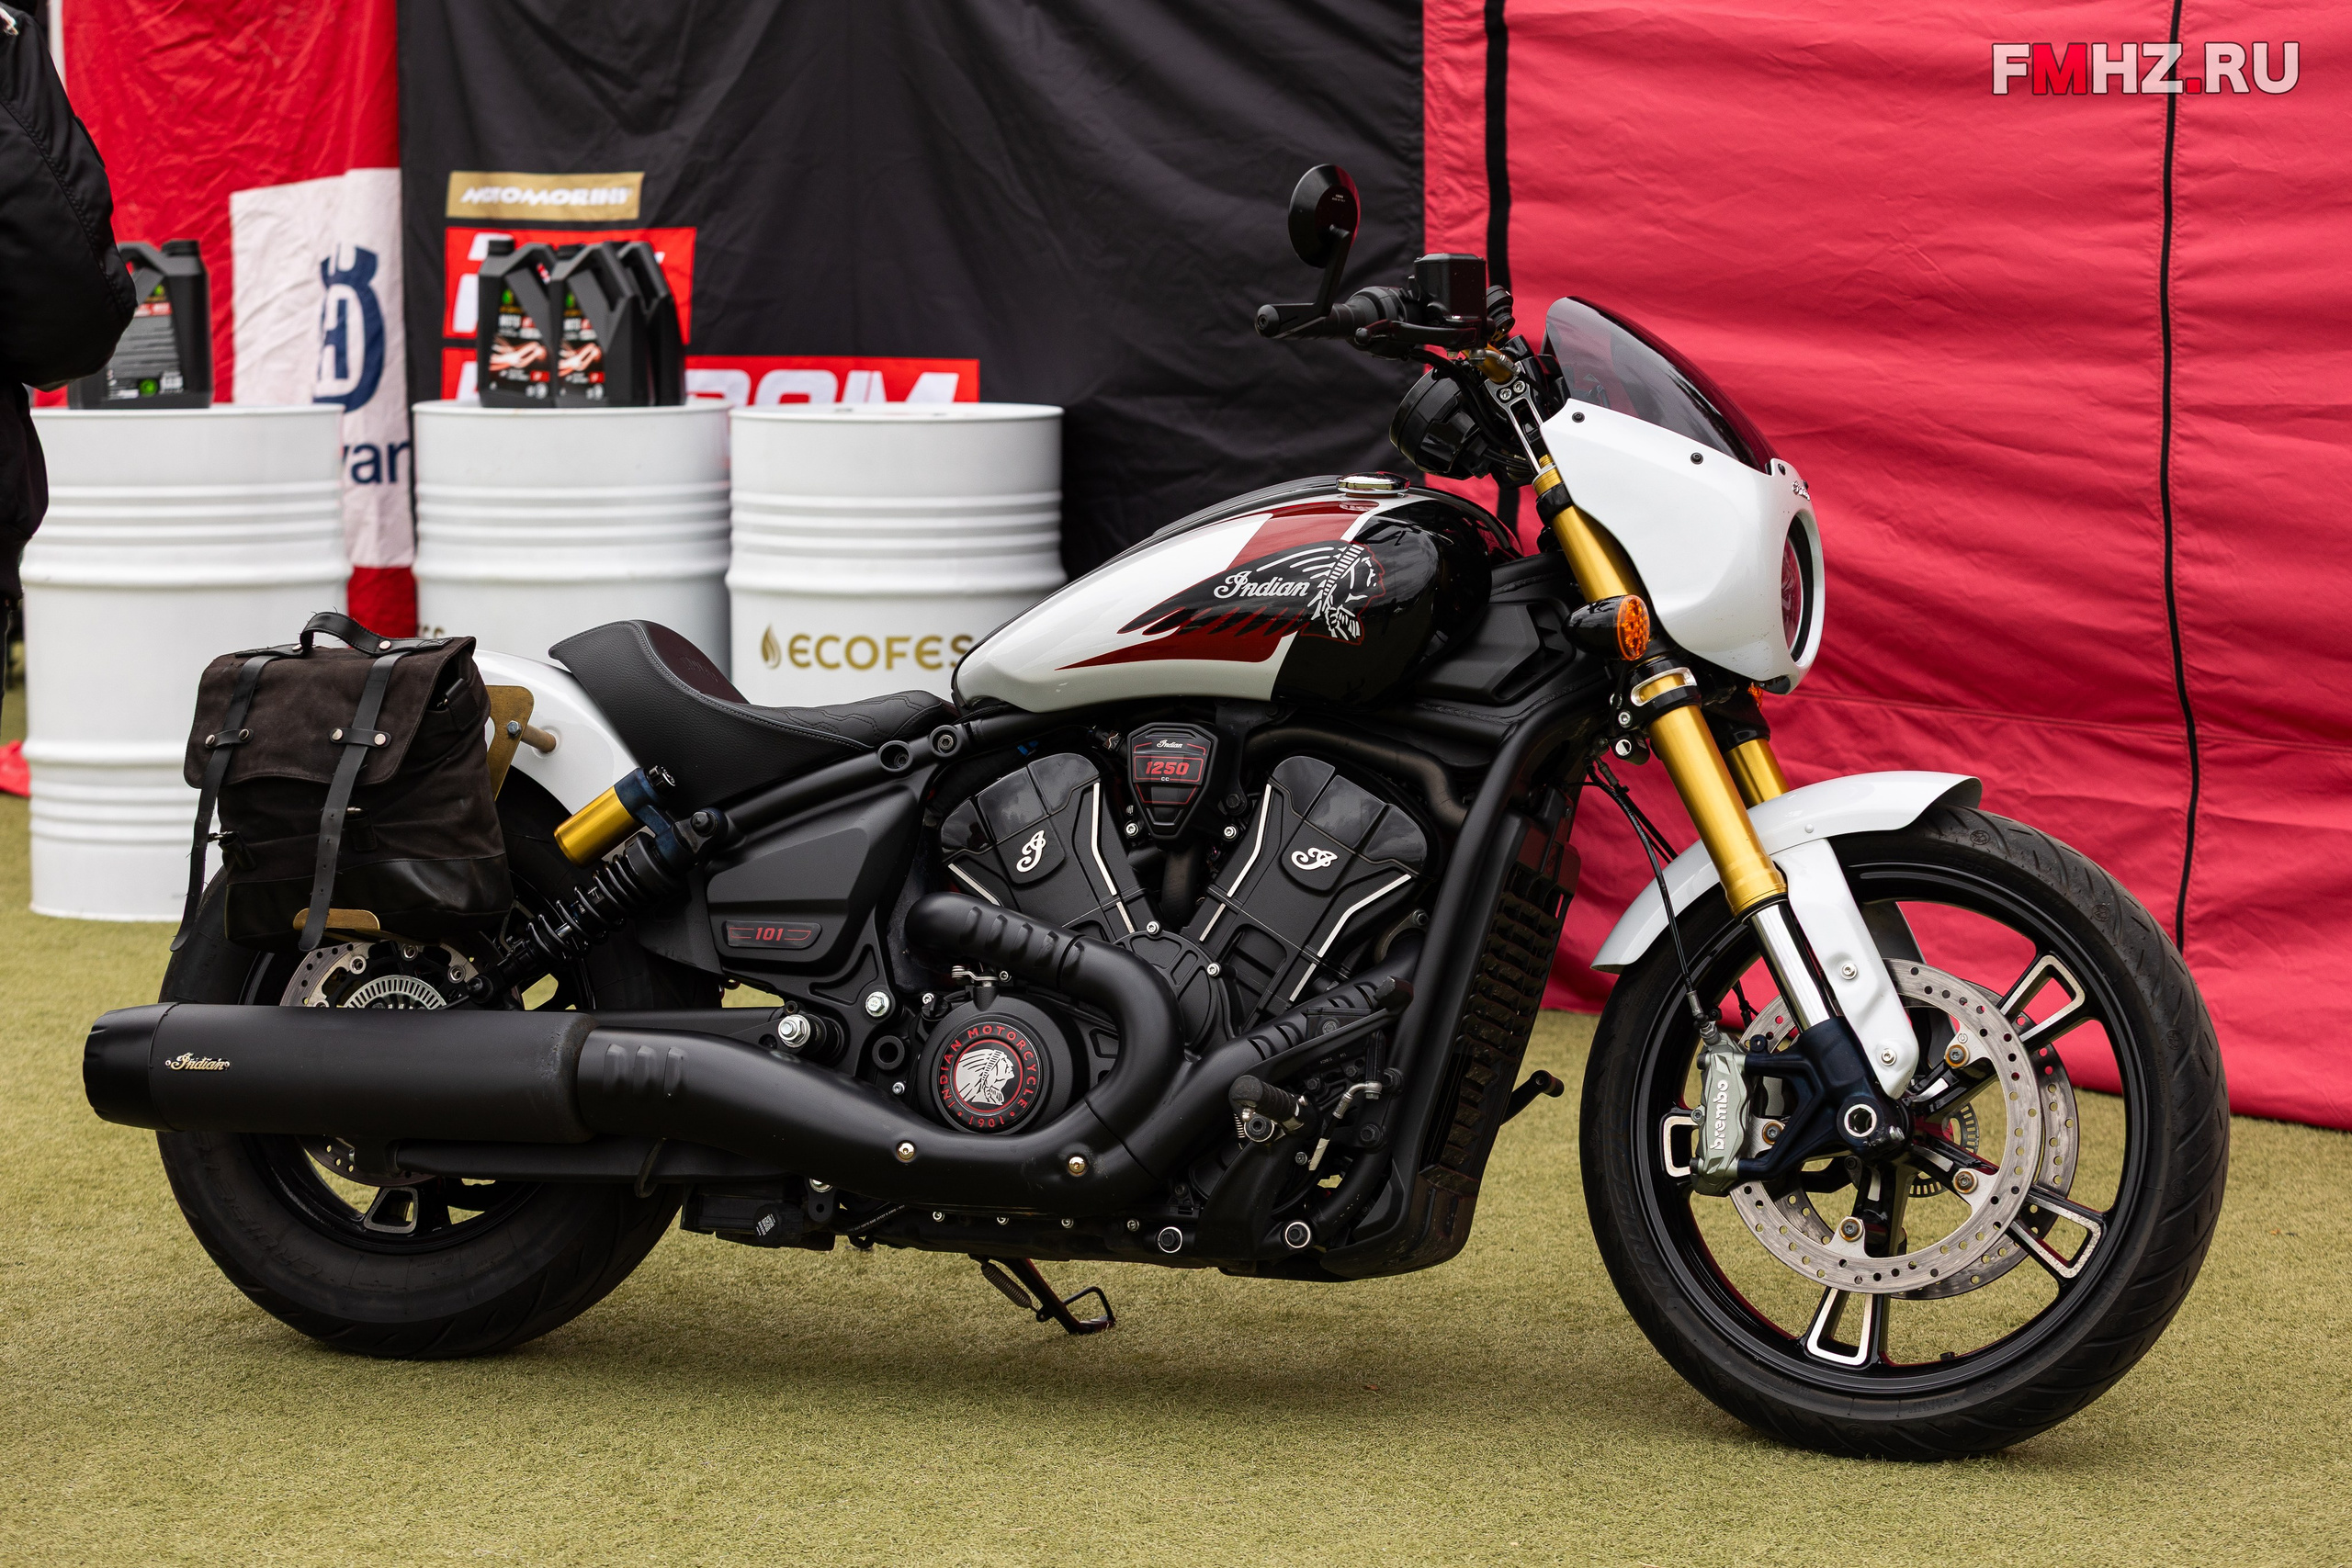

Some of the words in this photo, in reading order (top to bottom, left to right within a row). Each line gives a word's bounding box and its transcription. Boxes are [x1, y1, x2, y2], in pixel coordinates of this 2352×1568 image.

[342, 442, 411, 484] ar
[1213, 570, 1311, 599] Indian
[1156, 739, 1184, 749] Indian
[1145, 761, 1190, 776] 1250
[755, 927, 785, 942] 101
[169, 1052, 227, 1071] Indian
[939, 1039, 963, 1108] INDIAN
[967, 1024, 1038, 1109] MOTORCYCLE
[968, 1114, 1005, 1128] 1901
[1709, 1079, 1729, 1150] brembo
[191, 1132, 324, 1279] CRUISETE
